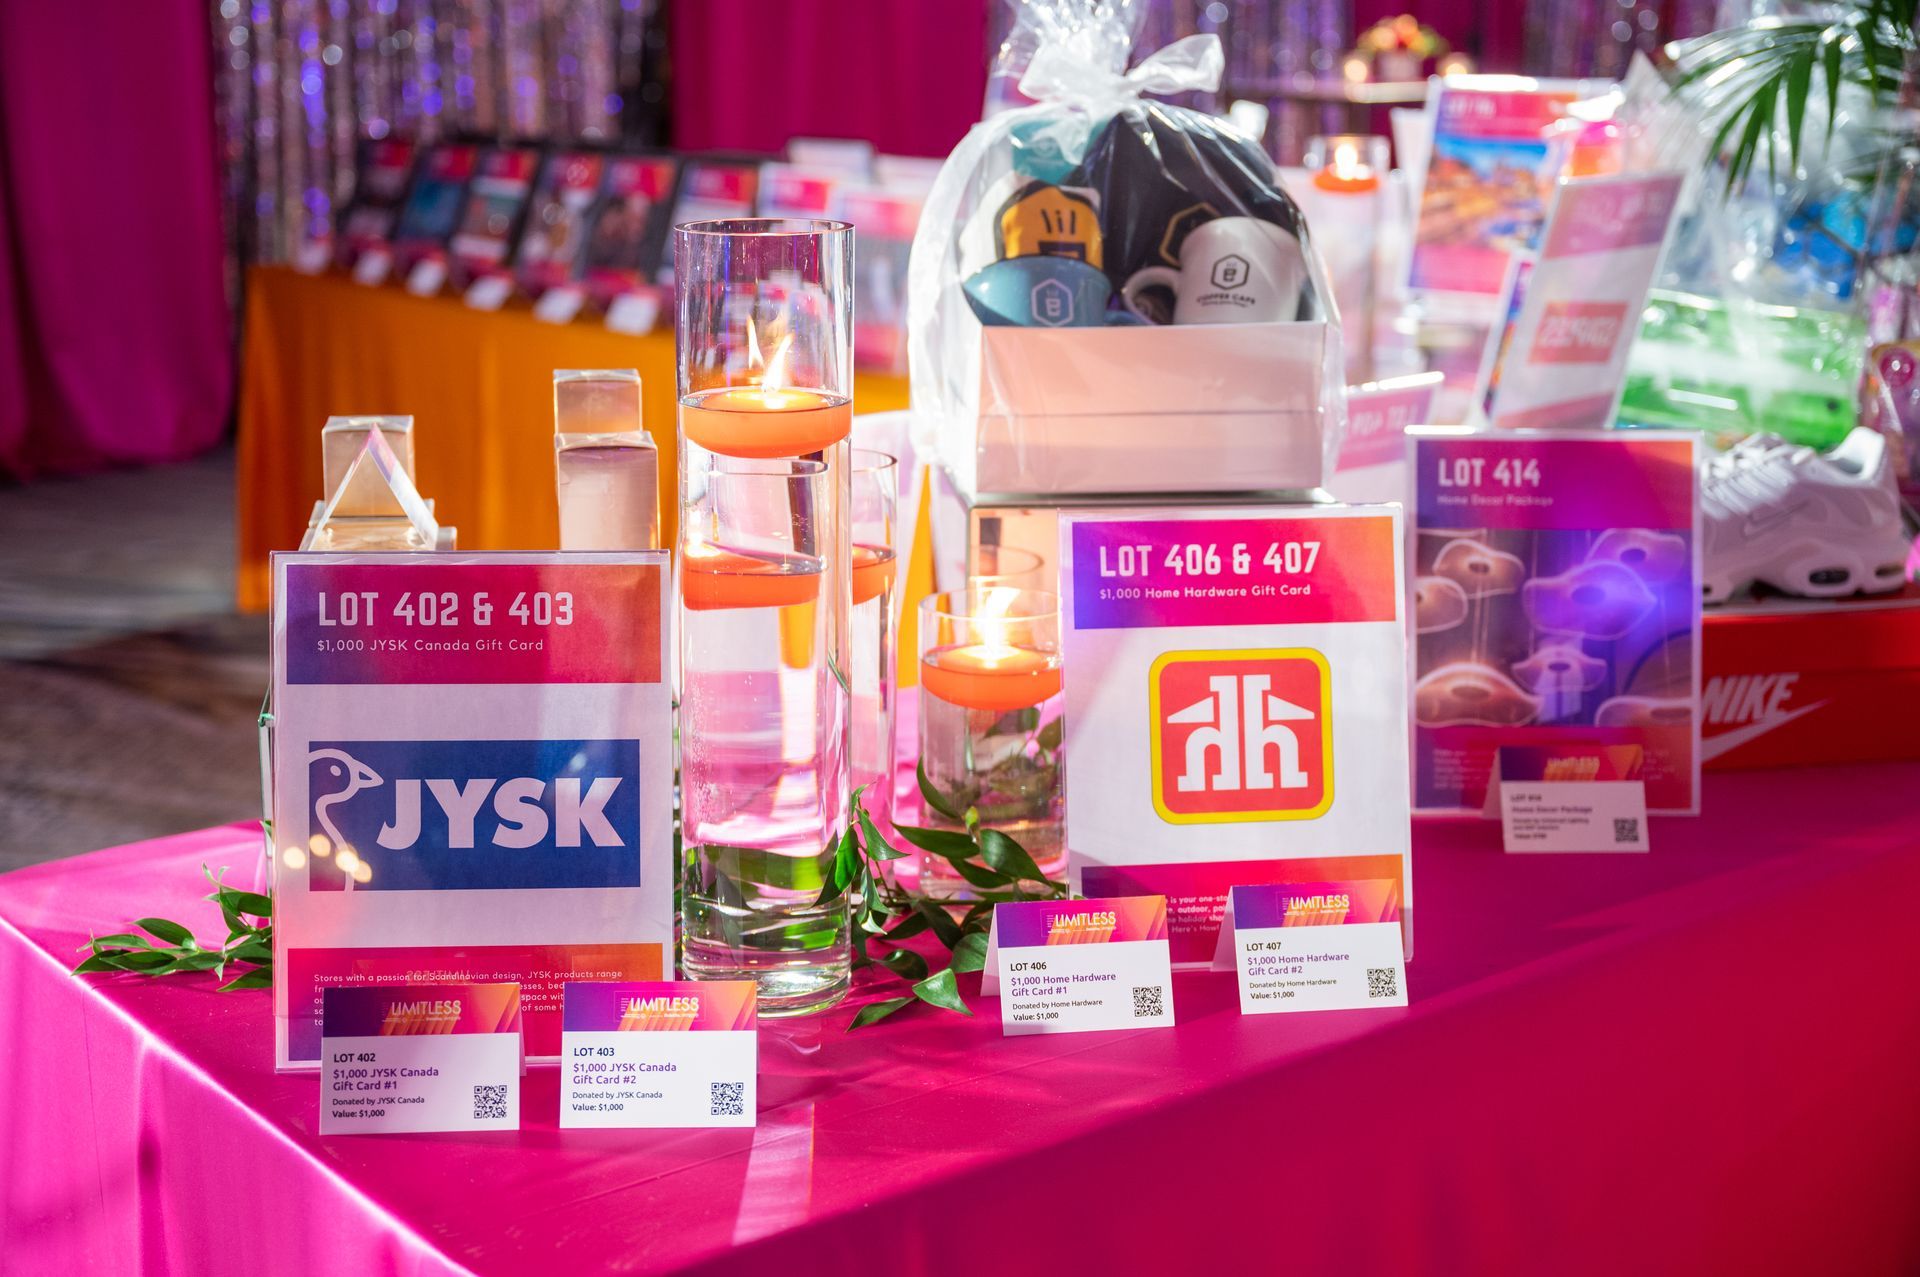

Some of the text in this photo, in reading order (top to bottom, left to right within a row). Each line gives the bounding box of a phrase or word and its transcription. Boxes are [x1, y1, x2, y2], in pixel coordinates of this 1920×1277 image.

[1438, 458, 1541, 487] LOT 414
[1437, 495, 1468, 505] Home
[1506, 494, 1553, 507] Package
[1100, 541, 1321, 577] LOT 406 & 407
[1100, 584, 1310, 600] $1,000 Home Hardware Gift Card
[318, 592, 573, 626] LOT 402 & 403
[317, 639, 544, 652] $1,000 JYSK Canada Gift Card
[1701, 672, 1799, 723] NIKE
[376, 777, 626, 850] JYSK
[1170, 896, 1177, 904] is
[1171, 925, 1197, 933] Here's
[1246, 942, 1282, 952] LOT 407
[1247, 953, 1350, 966] $1,000 Home Hardware
[1010, 962, 1047, 972] LOT 406
[1248, 966, 1303, 976] Gift Card #2
[314, 973, 343, 982] Stores
[345, 973, 366, 982] with
[376, 974, 410, 983] passion
[429, 971, 490, 980] Scandinavian
[492, 972, 524, 980] design,
[527, 971, 551, 979] JYSK
[554, 971, 594, 980] products
[596, 971, 622, 979] range
[1011, 973, 1116, 986] $1,000 Home Hardware
[1249, 981, 1277, 989] Donated
[1012, 986, 1067, 997] Gift Card #1
[1273, 991, 1295, 999] $1,000
[520, 993, 547, 1002] space
[521, 1003, 532, 1011] of
[1012, 1002, 1040, 1010] Donated
[1071, 999, 1103, 1007] Hardware
[1013, 1012, 1059, 1021] Value: $1,000
[574, 1047, 615, 1057] LOT 403
[333, 1053, 376, 1063] LOT 402
[573, 1062, 677, 1073] $1,000 JYSK Canada
[333, 1067, 439, 1080] $1,000 JYSK Canada
[573, 1075, 637, 1085] Gift Card #2
[333, 1081, 397, 1091] Gift Card #1
[332, 1096, 425, 1106] Donated by JYSK Canada
[605, 1092, 614, 1100] by
[598, 1103, 624, 1112] $1,000
[332, 1109, 385, 1118] Value: $1,000
